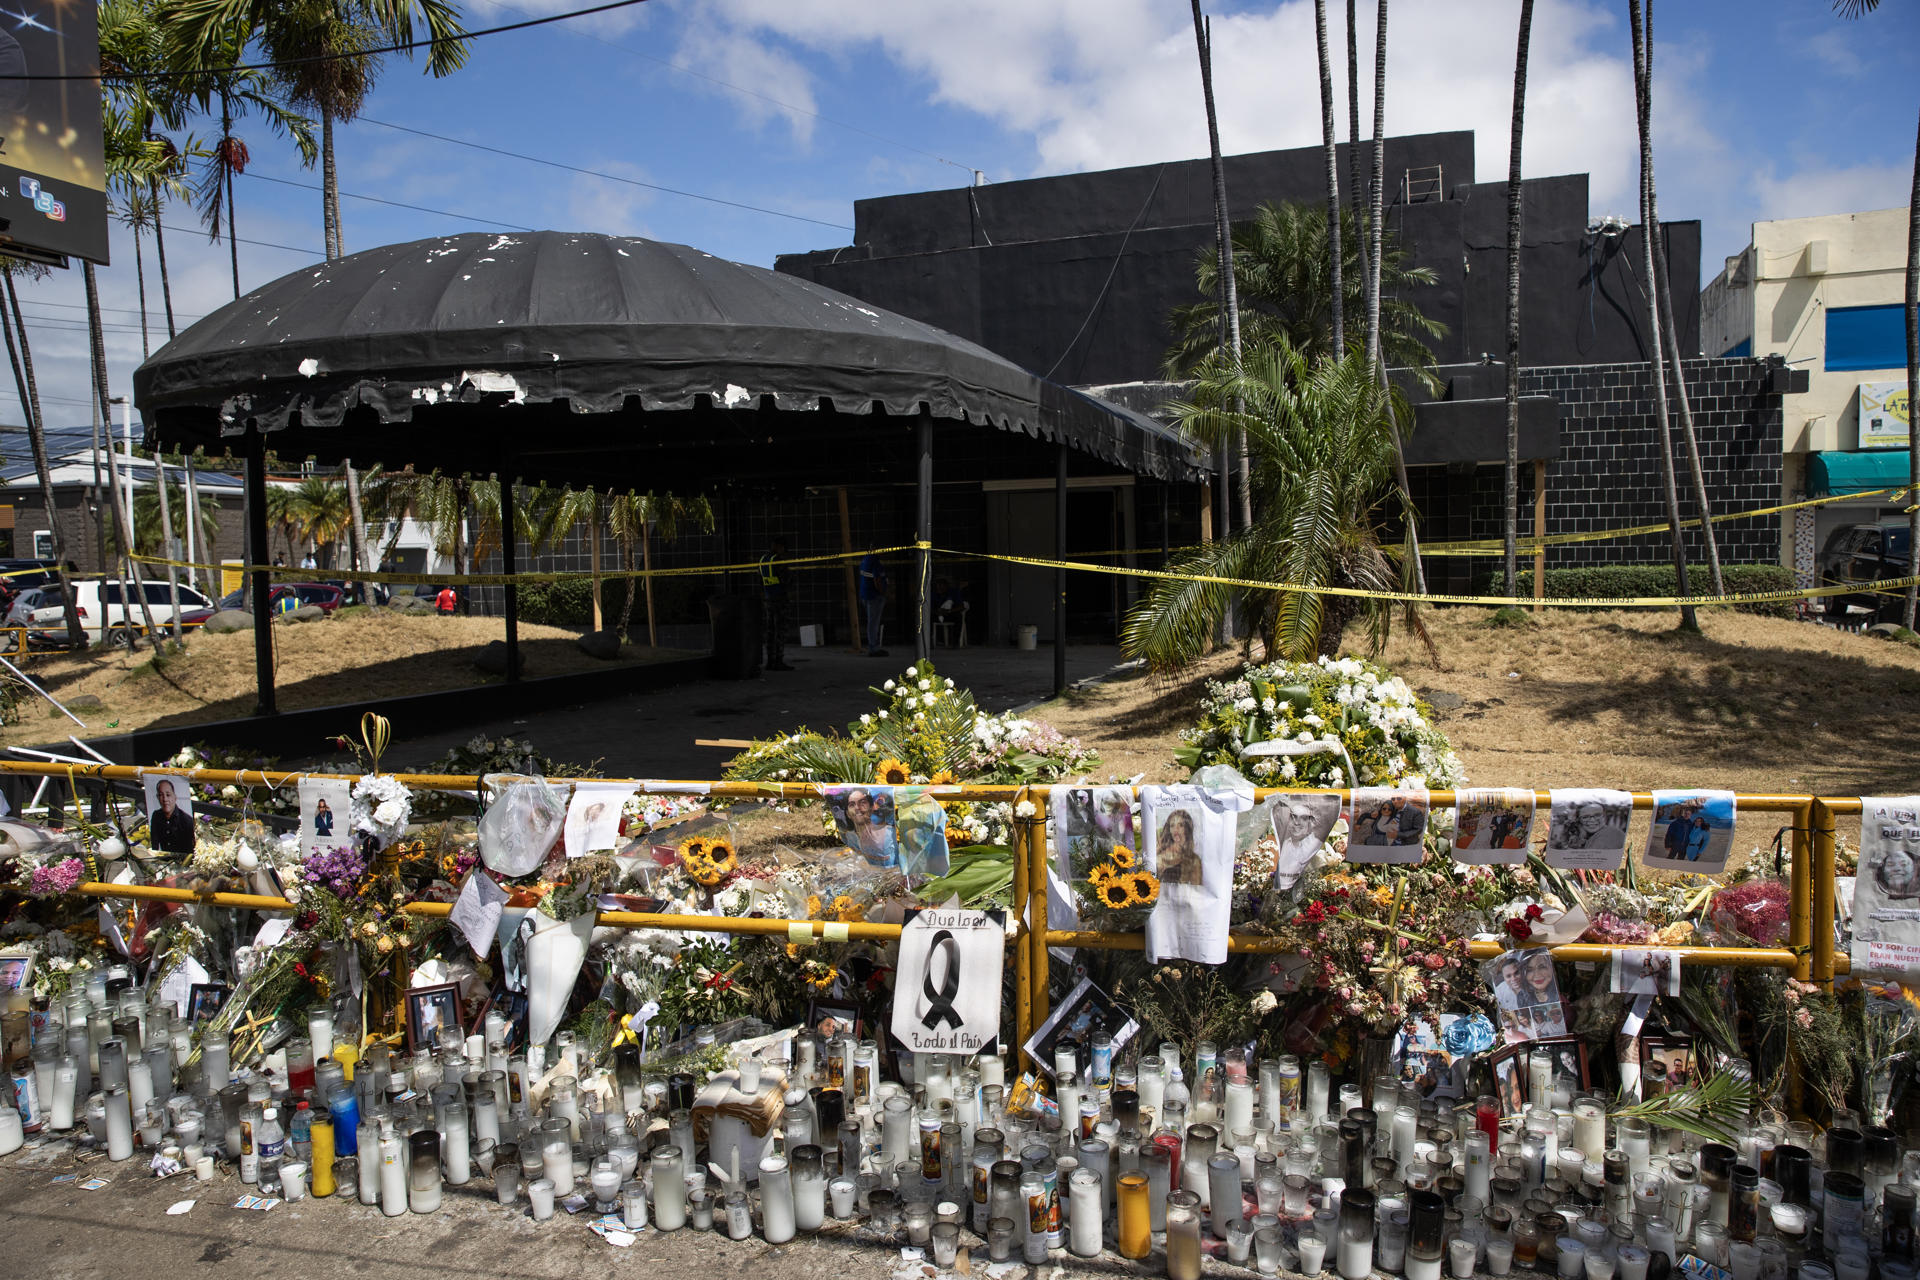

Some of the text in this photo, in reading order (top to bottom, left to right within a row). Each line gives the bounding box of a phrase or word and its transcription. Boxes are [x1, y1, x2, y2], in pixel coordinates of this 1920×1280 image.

[1882, 830, 1903, 838] QUE
[1870, 941, 1883, 950] NO
[1886, 943, 1904, 951] SON
[911, 1032, 947, 1049] Todo
[960, 1032, 983, 1050] País
